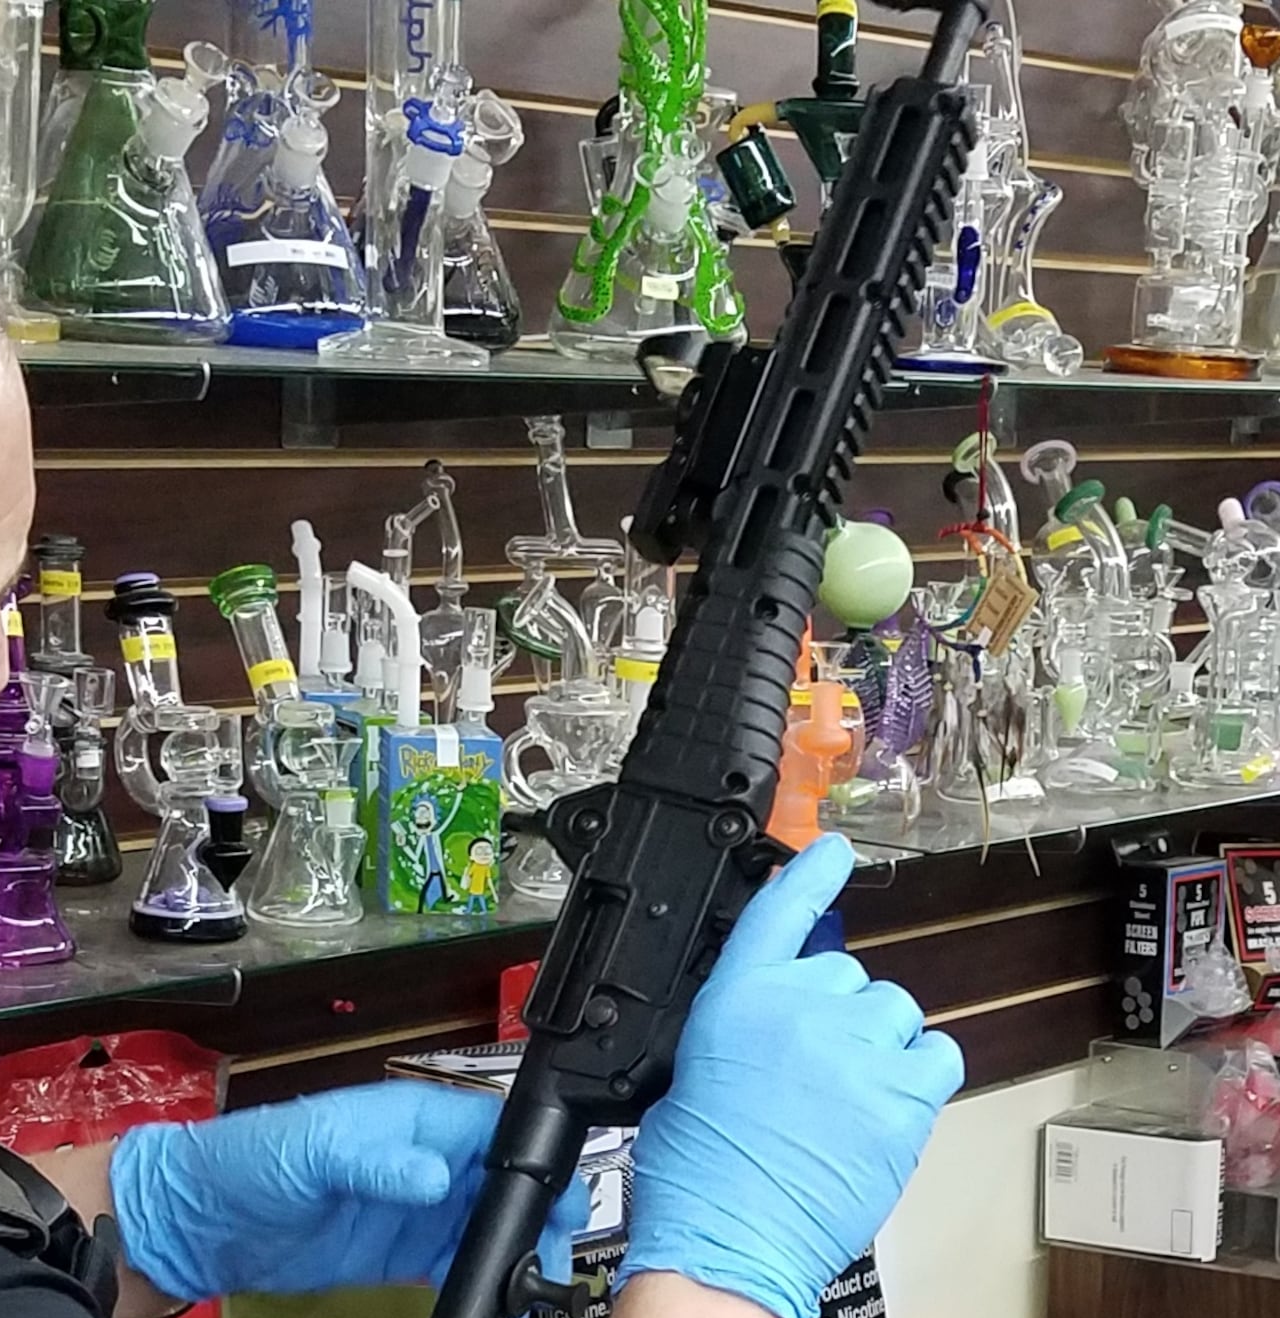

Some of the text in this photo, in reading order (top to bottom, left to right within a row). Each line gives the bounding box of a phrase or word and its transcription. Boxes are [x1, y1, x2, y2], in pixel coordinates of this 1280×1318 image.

[1138, 883, 1148, 899] 5
[1261, 881, 1277, 905] 5
[1125, 923, 1158, 940] SCREEN
[1124, 939, 1158, 957] FILTERS
